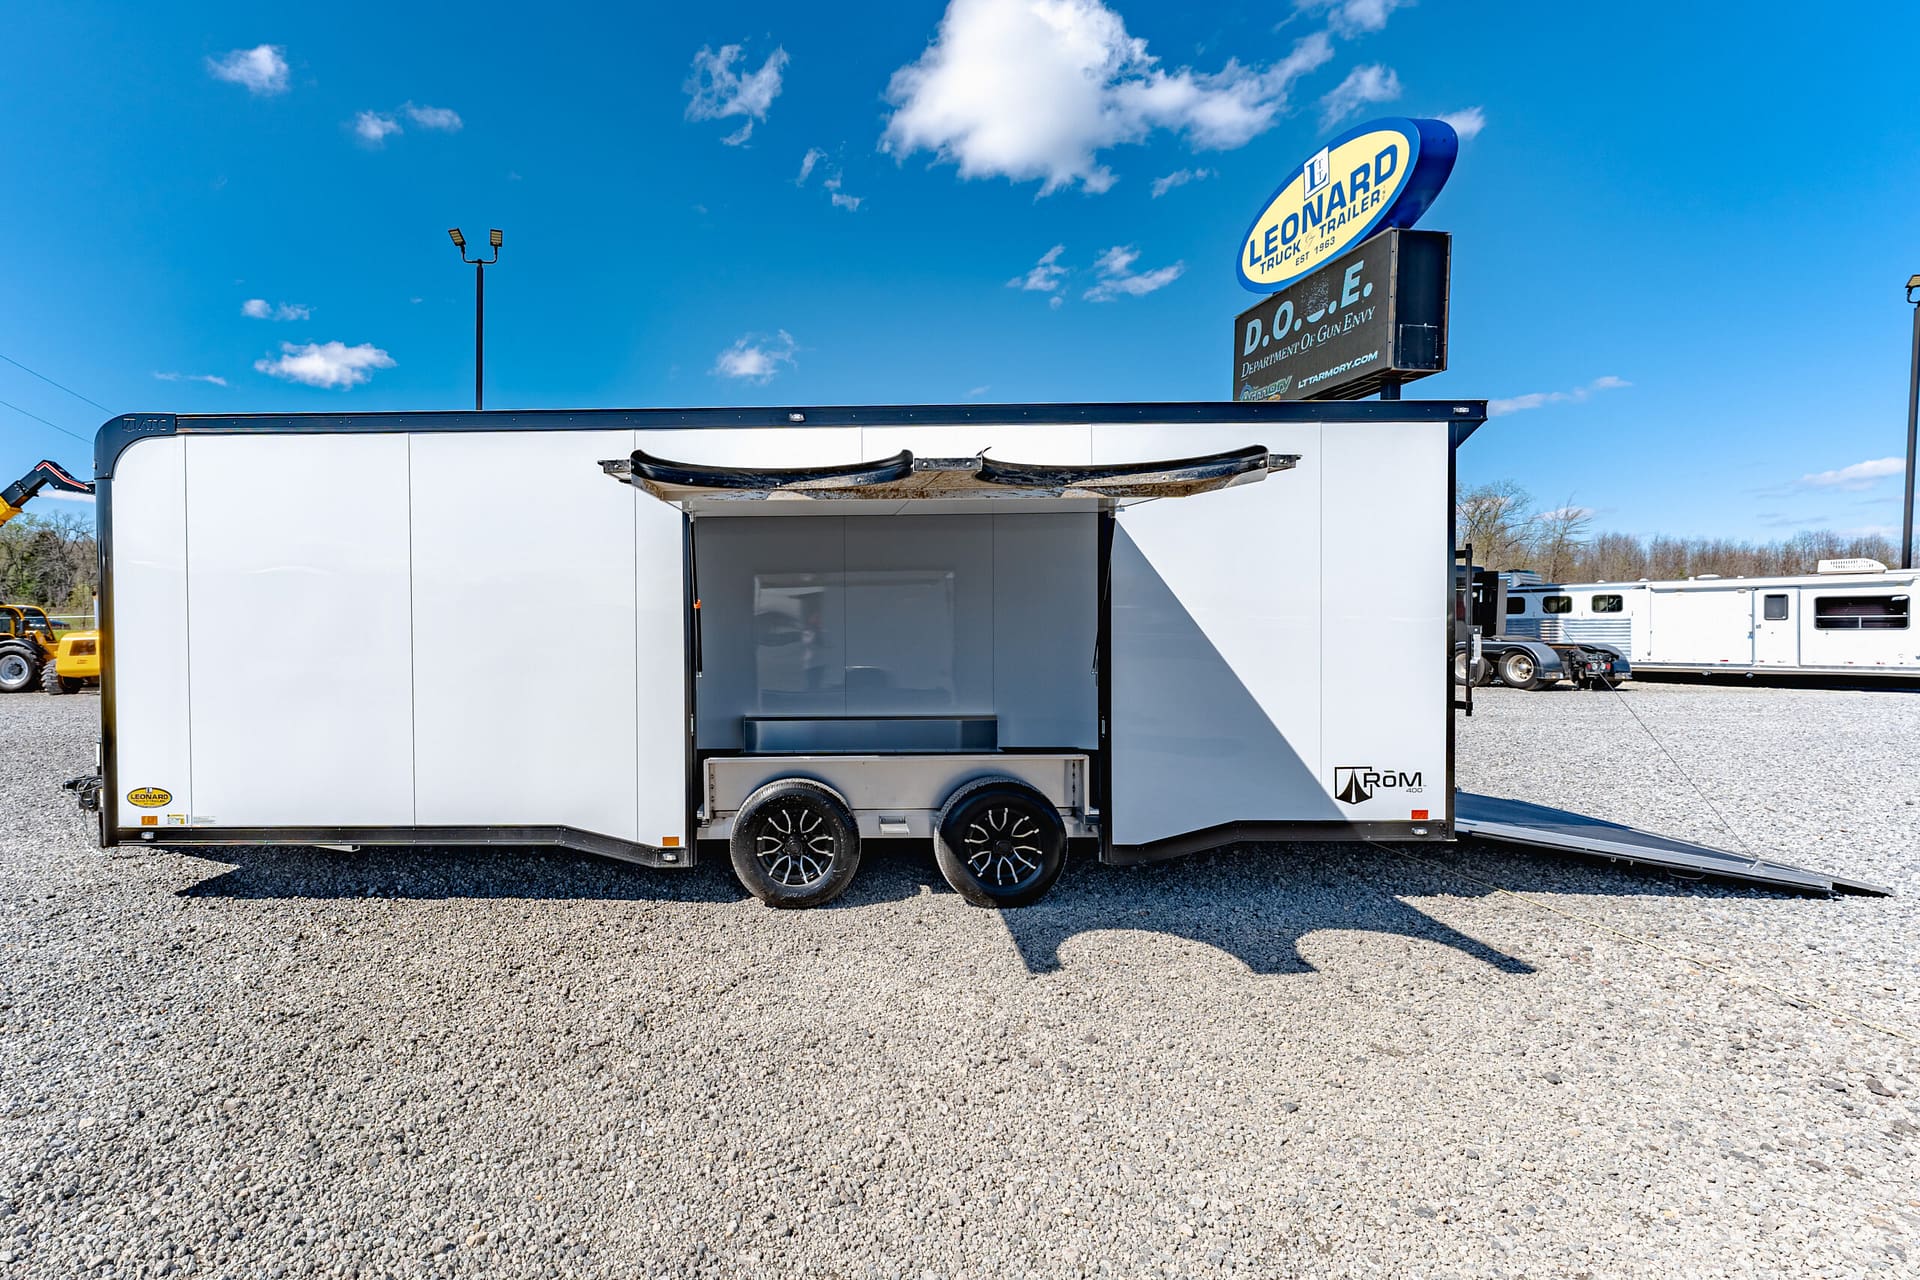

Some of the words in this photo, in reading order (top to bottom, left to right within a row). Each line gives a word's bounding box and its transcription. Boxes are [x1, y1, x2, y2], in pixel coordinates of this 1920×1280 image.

[1249, 144, 1398, 268] LEONARD
[1259, 239, 1301, 276] TRUCK
[1318, 188, 1381, 239] TRAILER
[1295, 251, 1311, 267] EST
[1313, 235, 1336, 255] 1963
[1297, 350, 1379, 389] LTTARMORY.COM
